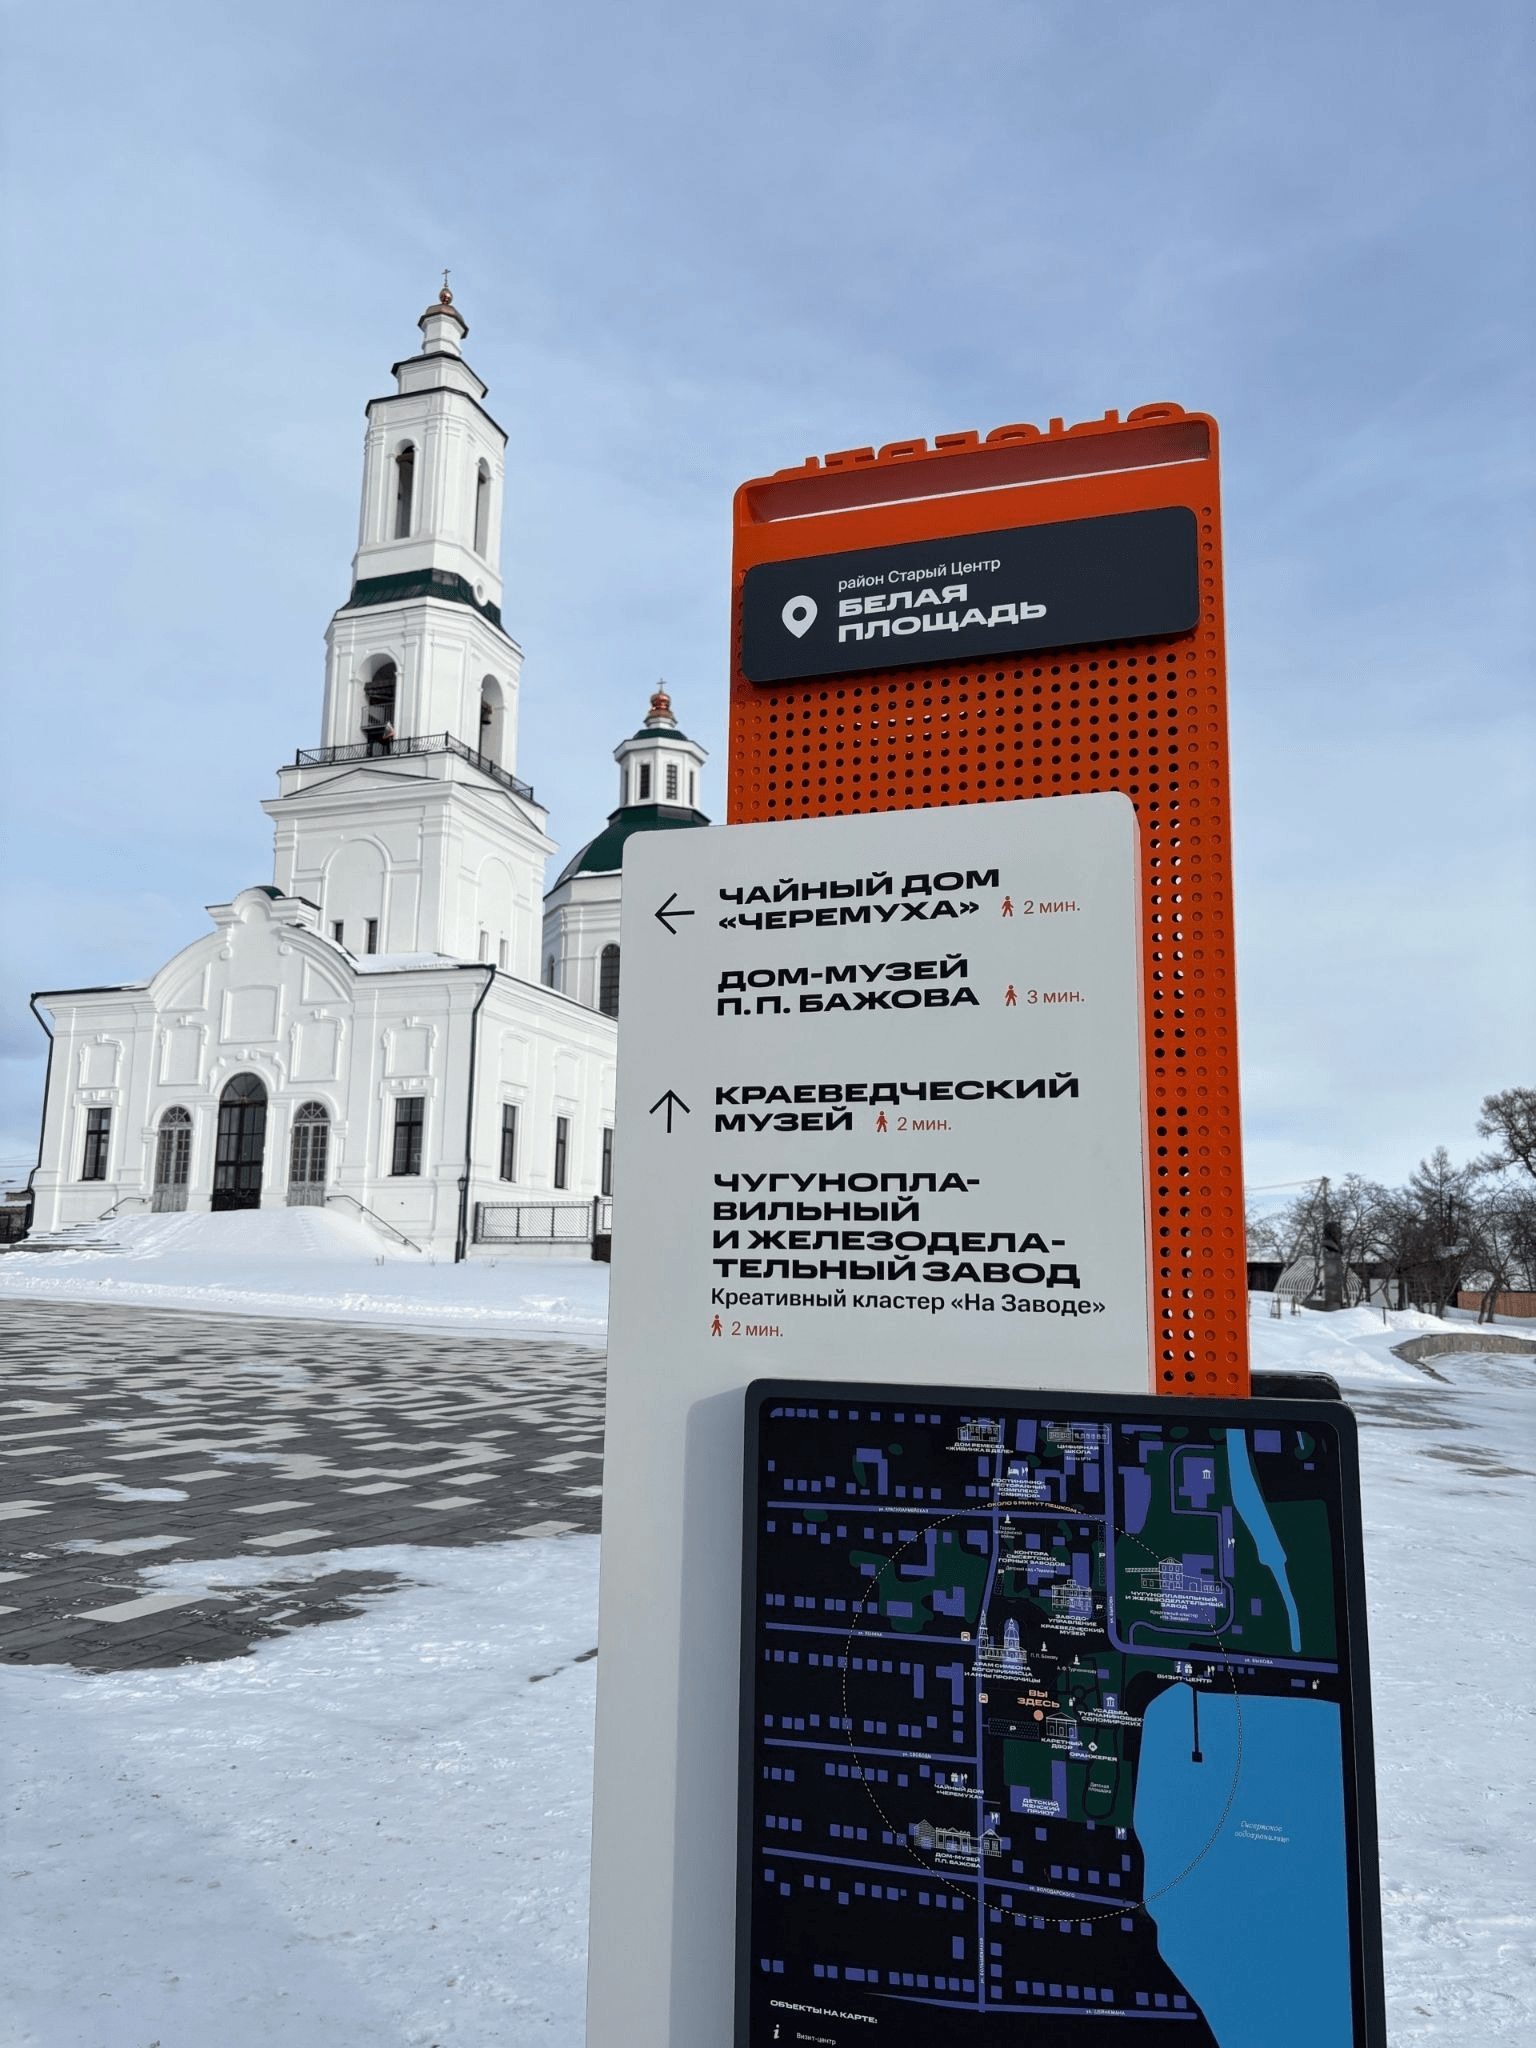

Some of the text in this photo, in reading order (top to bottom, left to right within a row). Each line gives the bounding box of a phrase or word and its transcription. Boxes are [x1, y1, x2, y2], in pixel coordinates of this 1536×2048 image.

[839, 560, 1000, 592] район Старый Центр
[838, 583, 968, 618] БЕЛАЯ
[838, 601, 1047, 643] ПЛОЩАДЬ
[720, 869, 999, 905] ЧАЙНЫЙ ДОМ
[1024, 901, 1080, 914] 2 мин.
[719, 900, 979, 930] «ЧЕРЕМУХА»
[718, 953, 967, 993] ДОМ-МУЗЕЙ
[800, 987, 980, 1012] БАЖОВА
[1028, 990, 1084, 1004] 3 мин.
[716, 1072, 1079, 1106] КРАЕВЕДЧЕСКИЙ
[715, 1106, 852, 1132] МУЗЕЙ
[898, 1117, 951, 1130] 2 мин.
[714, 1173, 979, 1192] ЧУГУНОПЛА-
[714, 1196, 919, 1221] ВИЛЬНЫЙ
[713, 1230, 1065, 1256] И ЖЕЛЕЗОДЕЛА-
[713, 1255, 1080, 1289] ТЕЛЬНЫЙ ЗАВОД
[712, 1288, 1105, 1317] Креативный кластер «На Заводе»
[732, 1321, 783, 1336] 2 мин.
[1045, 1502, 1077, 1513] ПЕШКОМ
[1130, 1591, 1217, 1602] ЧУГУНОПЛАВИЛЬНЫЙ
[1132, 1596, 1223, 1607] ЖЕЛЕЗОДЕЛАТЕЛЬНЫЙ
[1041, 1624, 1105, 1633] КРАЕВЕДЧЕСКИЙ
[1048, 1618, 1097, 1627] УПРАВЛЕНИЕ
[995, 1663, 1031, 1671] СИМЕОНА
[970, 1672, 991, 1680] АННЫ
[992, 1674, 1041, 1683] ПРОРОЧИЦЫ
[1157, 1673, 1212, 1684] ВИЗИТ-ЦЕНТР
[1028, 1689, 1048, 1698] ВЫ
[1017, 1697, 1060, 1708] ЗДЕСЬ
[1093, 1708, 1128, 1716] УСАДЬБА
[1081, 1716, 1141, 1727] СОЛОМИРСКИХ
[1041, 1737, 1083, 1747] КАРЕТНЫЙ
[1069, 1751, 1117, 1762] ОРАНЖЕРЕЯ
[934, 1784, 966, 1792] ЧАЙНЫЙ
[1022, 1803, 1060, 1812] ЖЕНСКИЙ
[1023, 1798, 1059, 1806] ДЕТСКИЙ
[935, 1852, 980, 1862] ДОМ-МУЗЕЙ
[770, 2000, 878, 2024] ОБЪЕКТЫ НА КАРТЕ:
